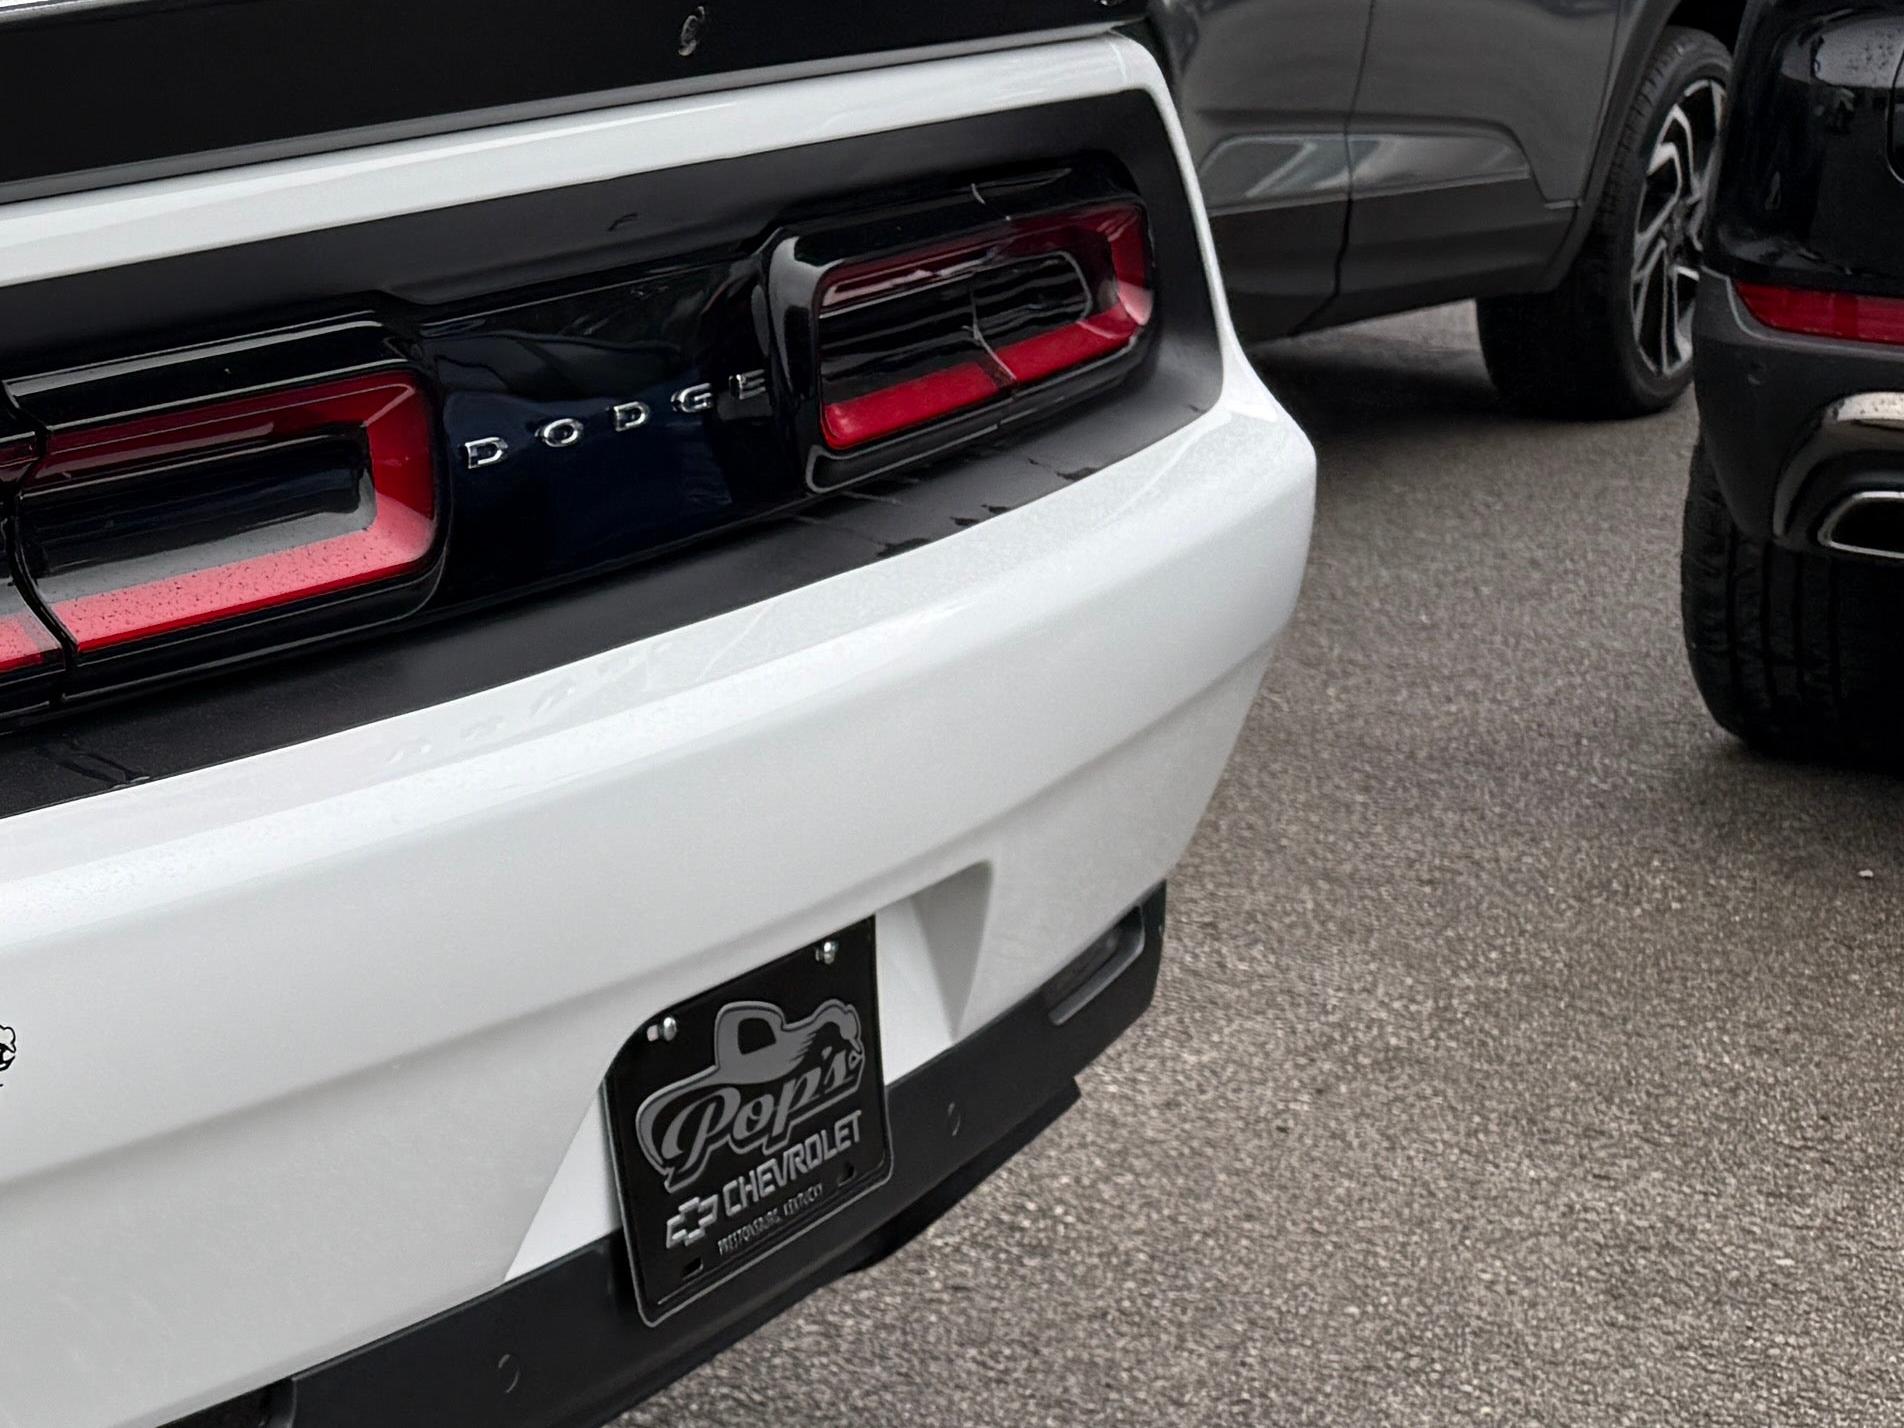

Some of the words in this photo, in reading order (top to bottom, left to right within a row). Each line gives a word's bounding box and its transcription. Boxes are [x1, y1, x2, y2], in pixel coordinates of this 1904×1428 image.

[464, 368, 767, 470] DODGE
[661, 1045, 864, 1176] Pop's
[723, 1109, 862, 1218] CHEVROLET
